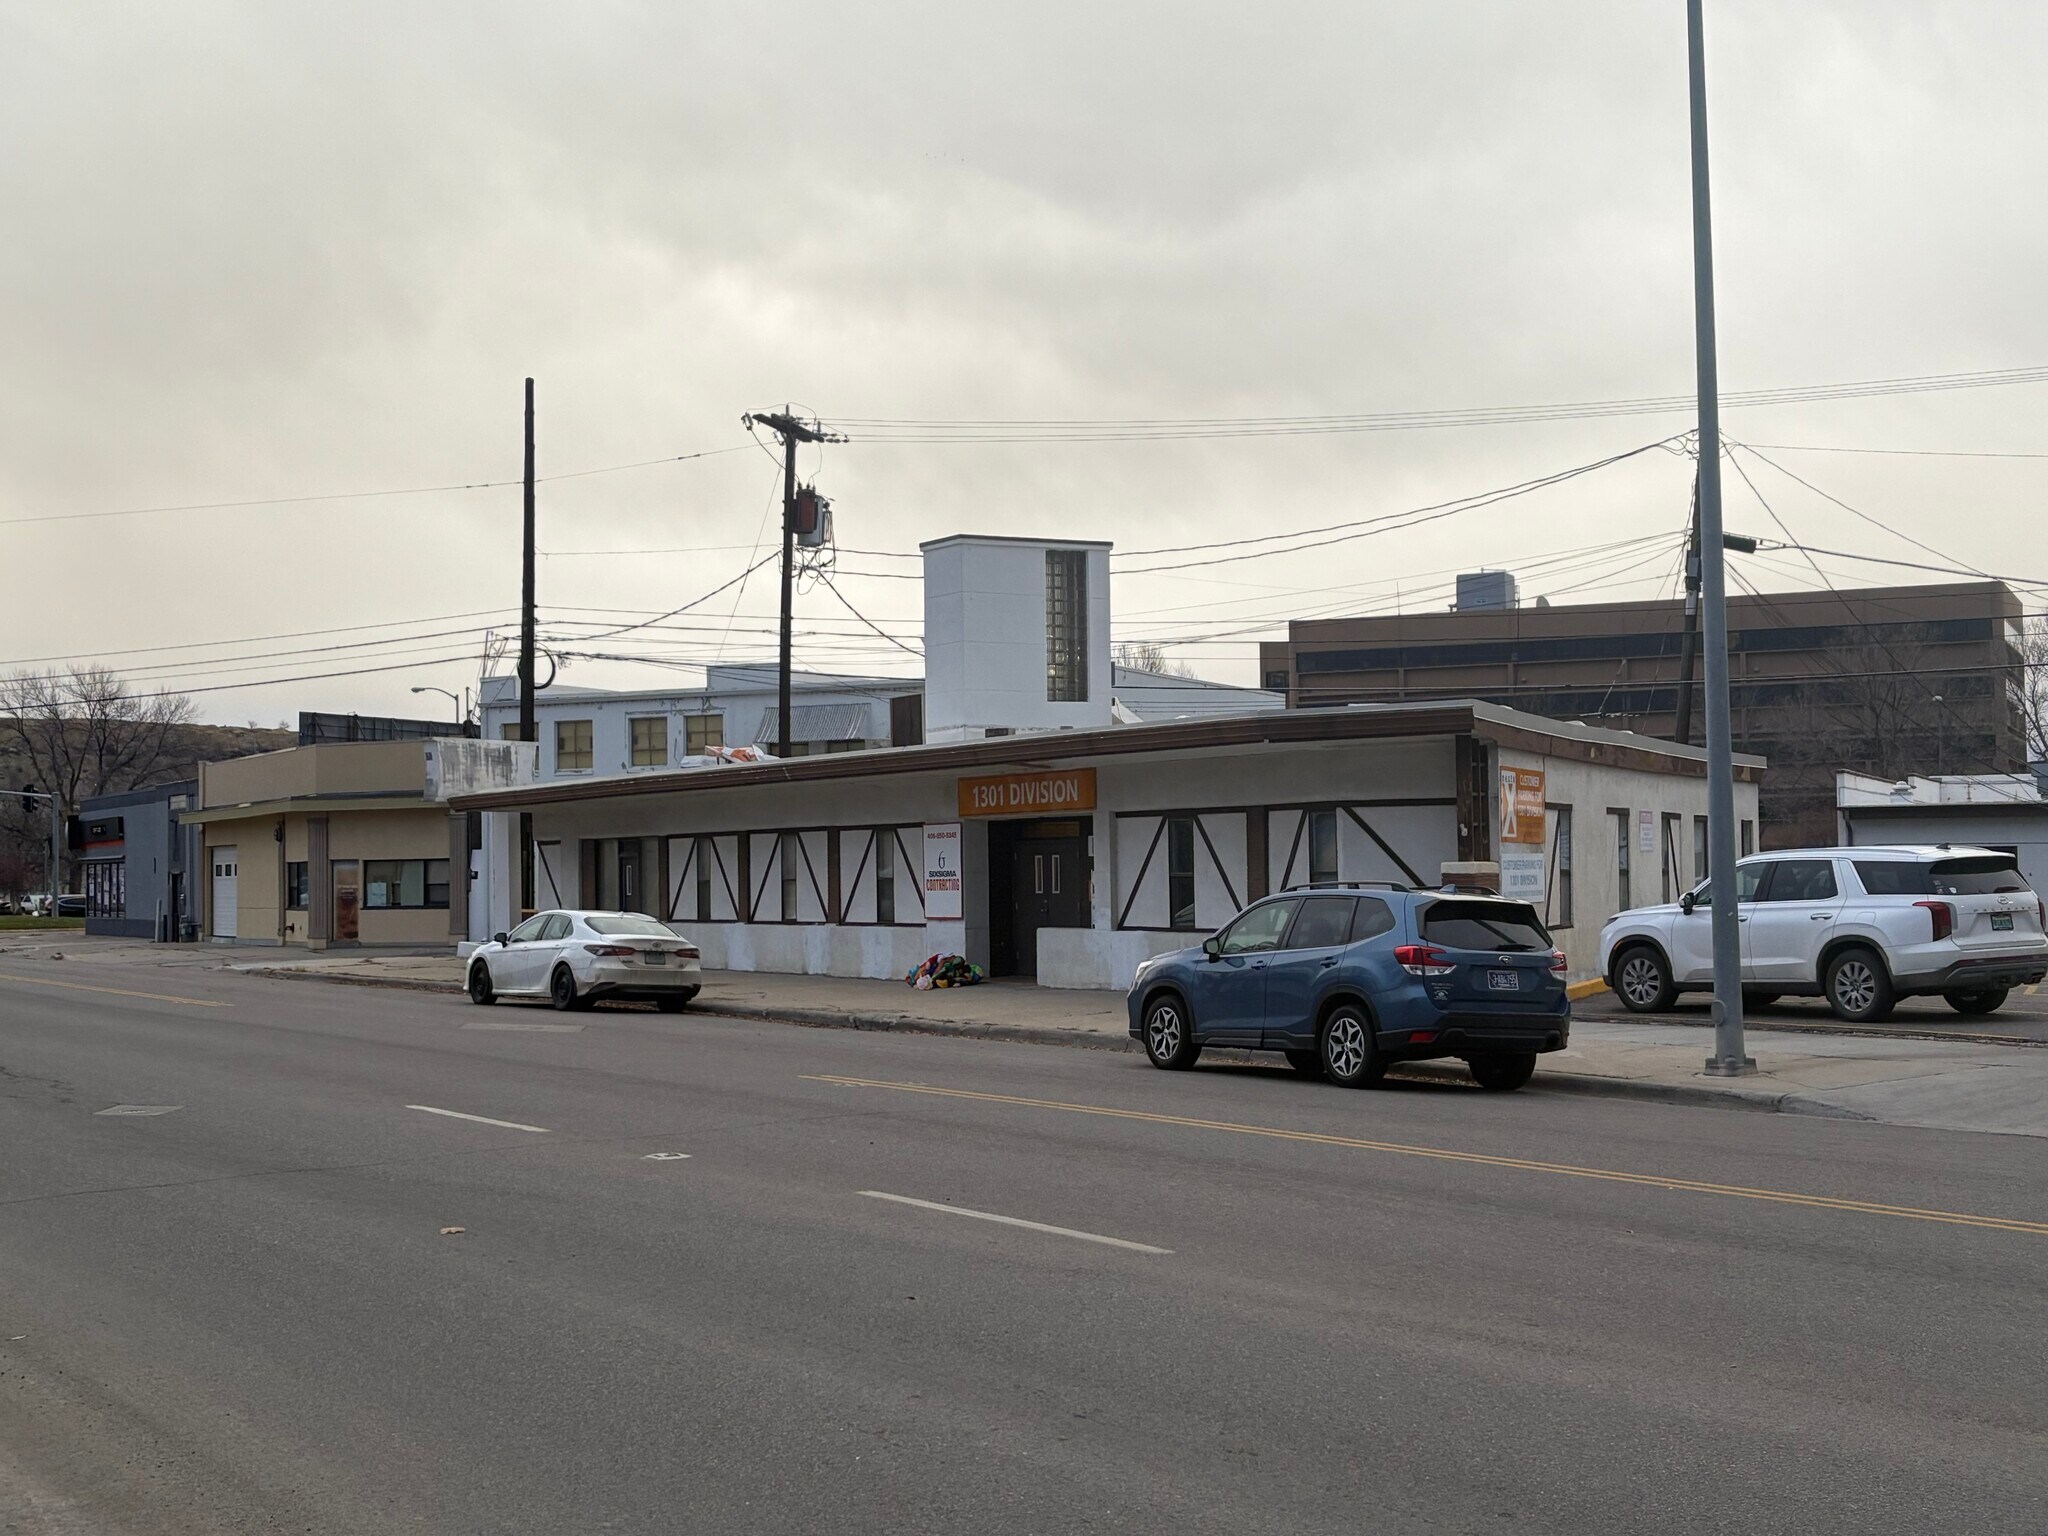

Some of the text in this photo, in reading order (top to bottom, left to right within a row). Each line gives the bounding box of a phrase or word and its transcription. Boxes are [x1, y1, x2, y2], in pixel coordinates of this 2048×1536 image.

[973, 778, 1078, 808] 1301 DIVISION
[926, 879, 960, 891] CONTRACTING
